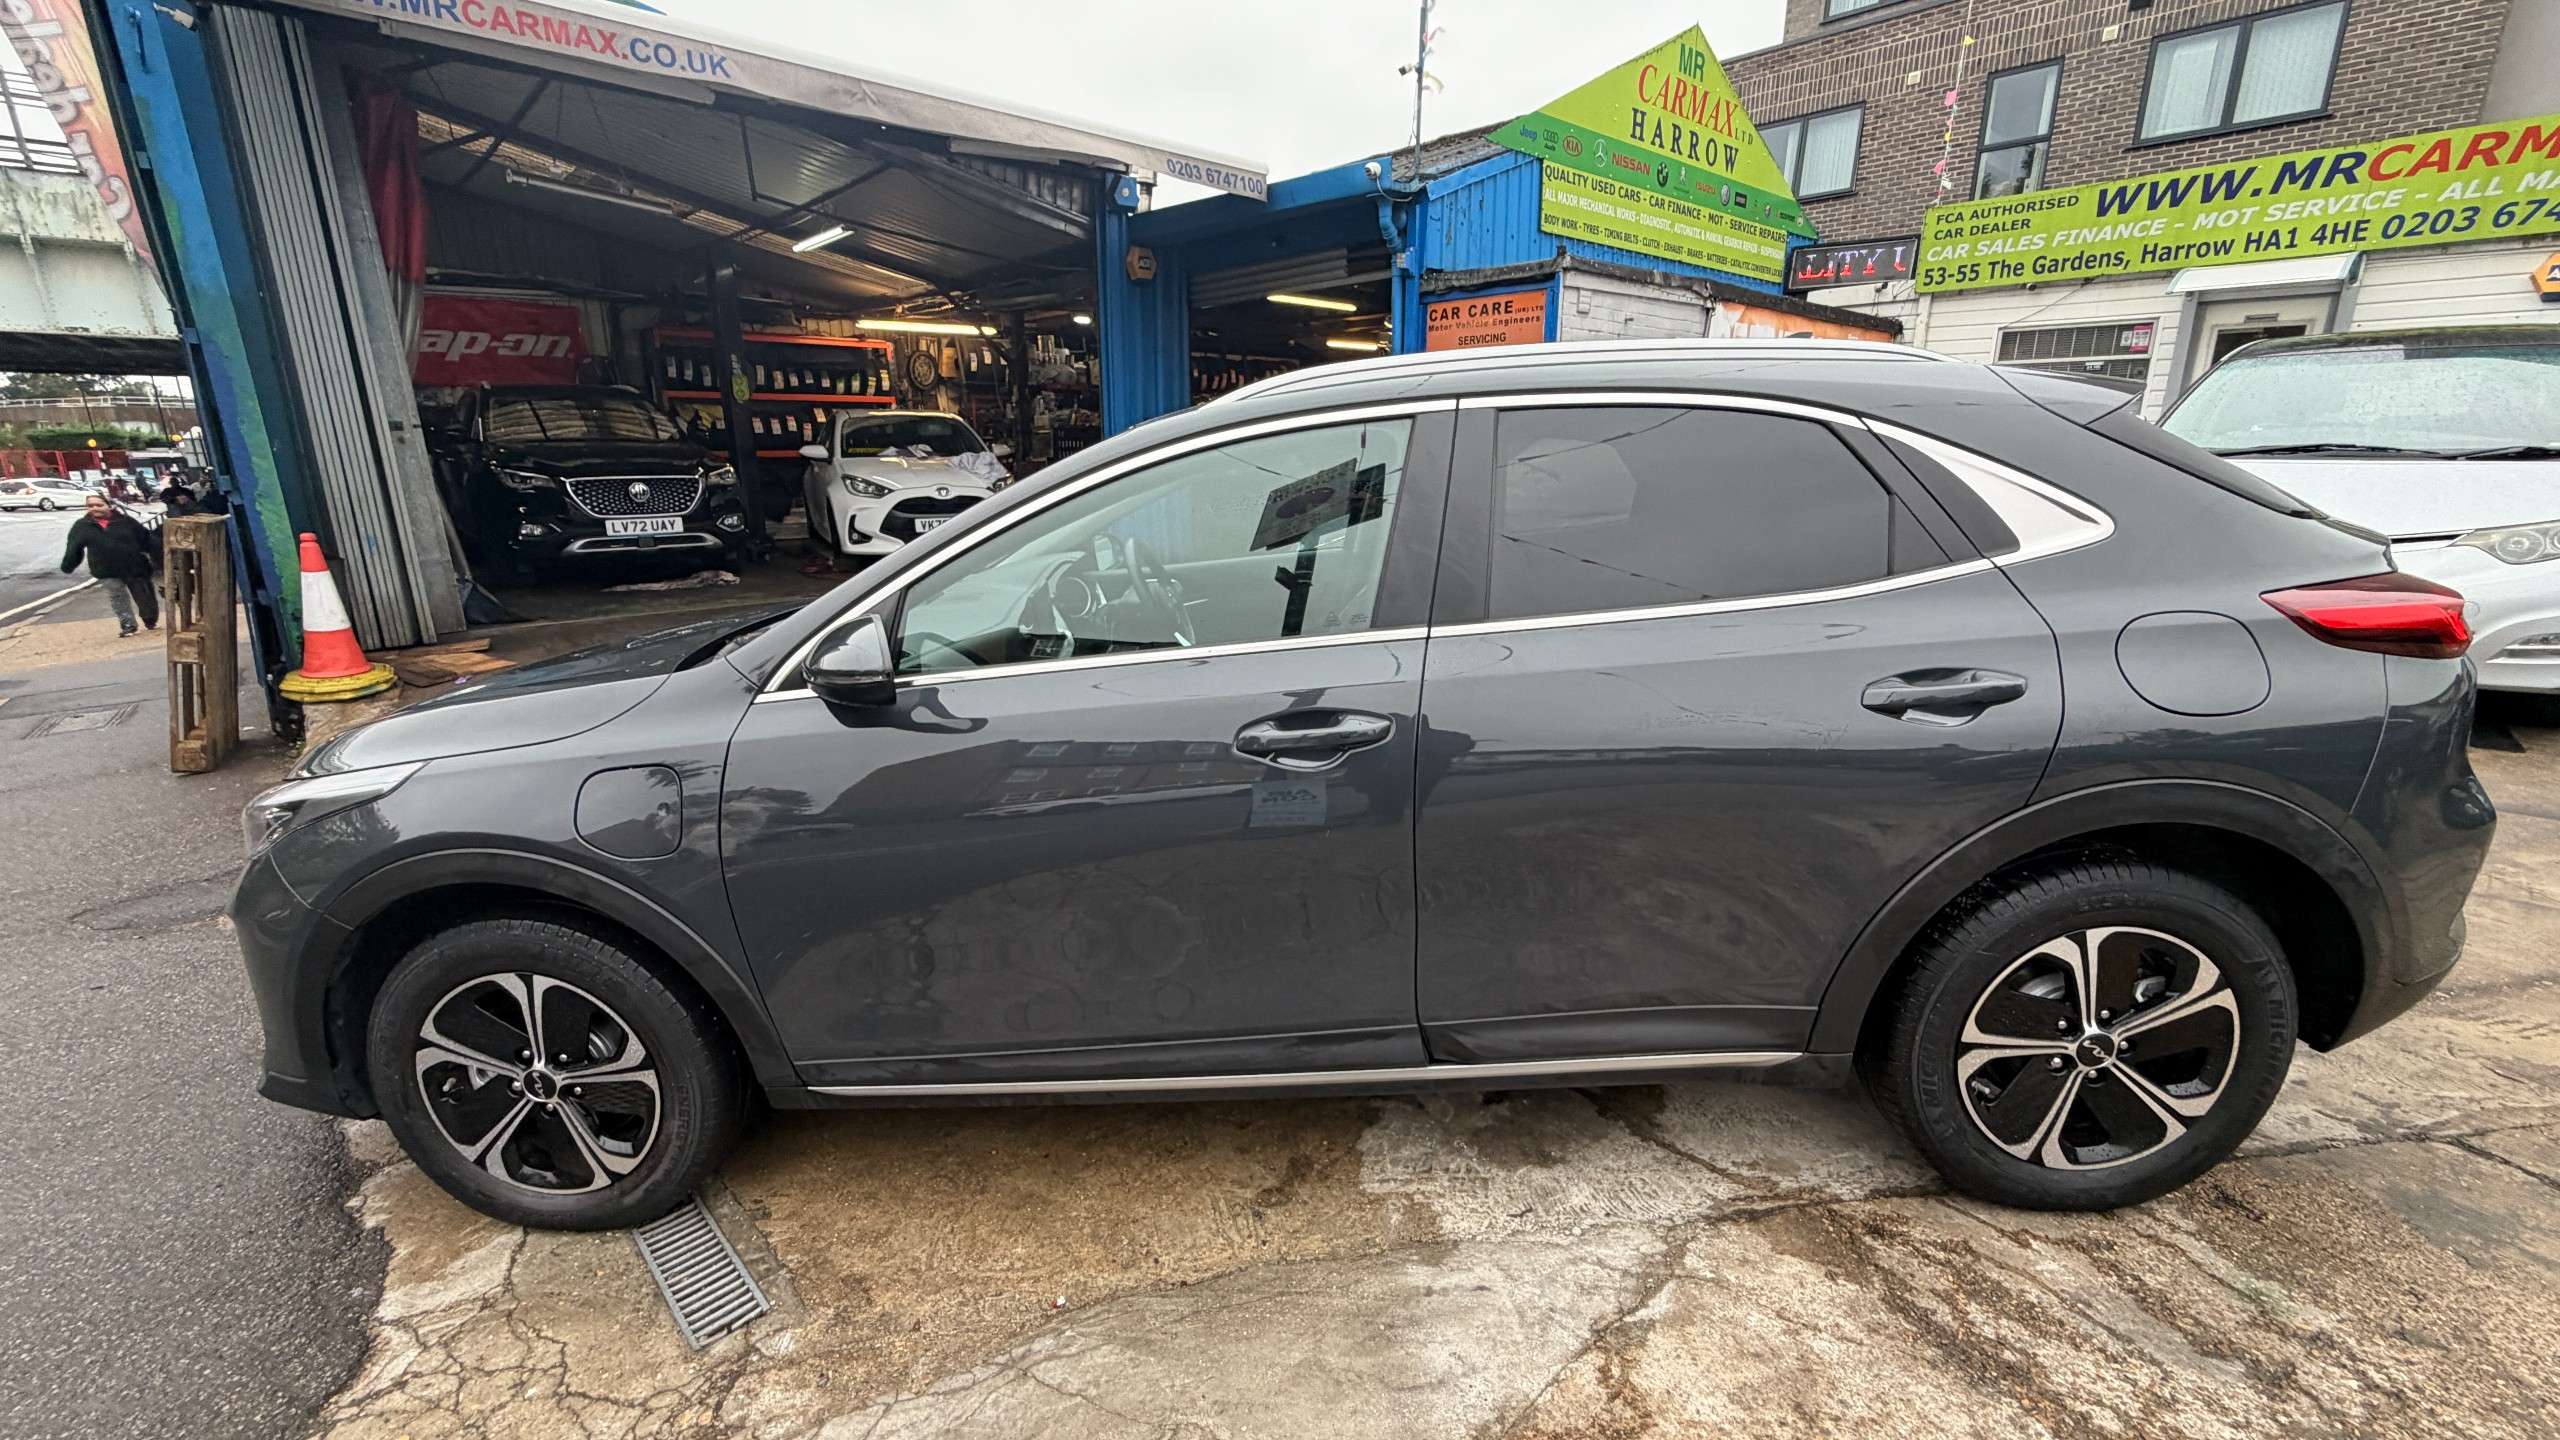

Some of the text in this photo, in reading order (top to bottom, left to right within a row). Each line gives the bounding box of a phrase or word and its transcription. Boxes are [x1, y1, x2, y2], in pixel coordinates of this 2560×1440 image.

[1679, 43, 1706, 82] MR
[1638, 64, 1754, 146] CARMAX LTD
[1630, 107, 1739, 174] HARROW
[1566, 142, 1579, 152] KIA
[1611, 152, 1651, 176] NISSAN
[1167, 158, 1263, 195] 0203 6747100
[1545, 164, 1786, 243] QUALITY USED CARS CAR FINANCE MOT SERVICE REPAIRS
[1558, 190, 1578, 207] MAJOR
[1936, 195, 2080, 225] FCA AUTHORISED
[1544, 213, 1559, 226] BODY
[1561, 218, 1578, 230] WORK
[1583, 222, 1600, 235] TYRES
[1926, 244, 1968, 262] CAR
[1974, 233, 2048, 257] SALES
[2052, 218, 2168, 248] FINANCE
[2192, 206, 2261, 231] MOT
[2263, 187, 2407, 222] SERVICE
[2438, 176, 2503, 203] ALL
[1934, 218, 2032, 241] CAR DEALER
[1922, 262, 1981, 287] 53-55
[1988, 260, 2025, 282] The
[2032, 249, 2131, 276] Gardens,
[2140, 238, 2236, 264] Harrow
[2244, 226, 2298, 253] HA1
[2310, 218, 2371, 246] 4HE
[2380, 206, 2481, 241] 0203
[1428, 306, 1460, 322] CAR
[1468, 300, 1514, 318] CARE
[1428, 315, 1541, 332] Motor Vehicle Engineers
[1458, 332, 1507, 346] SERVICING
[610, 519, 677, 533] LV72 UAY
